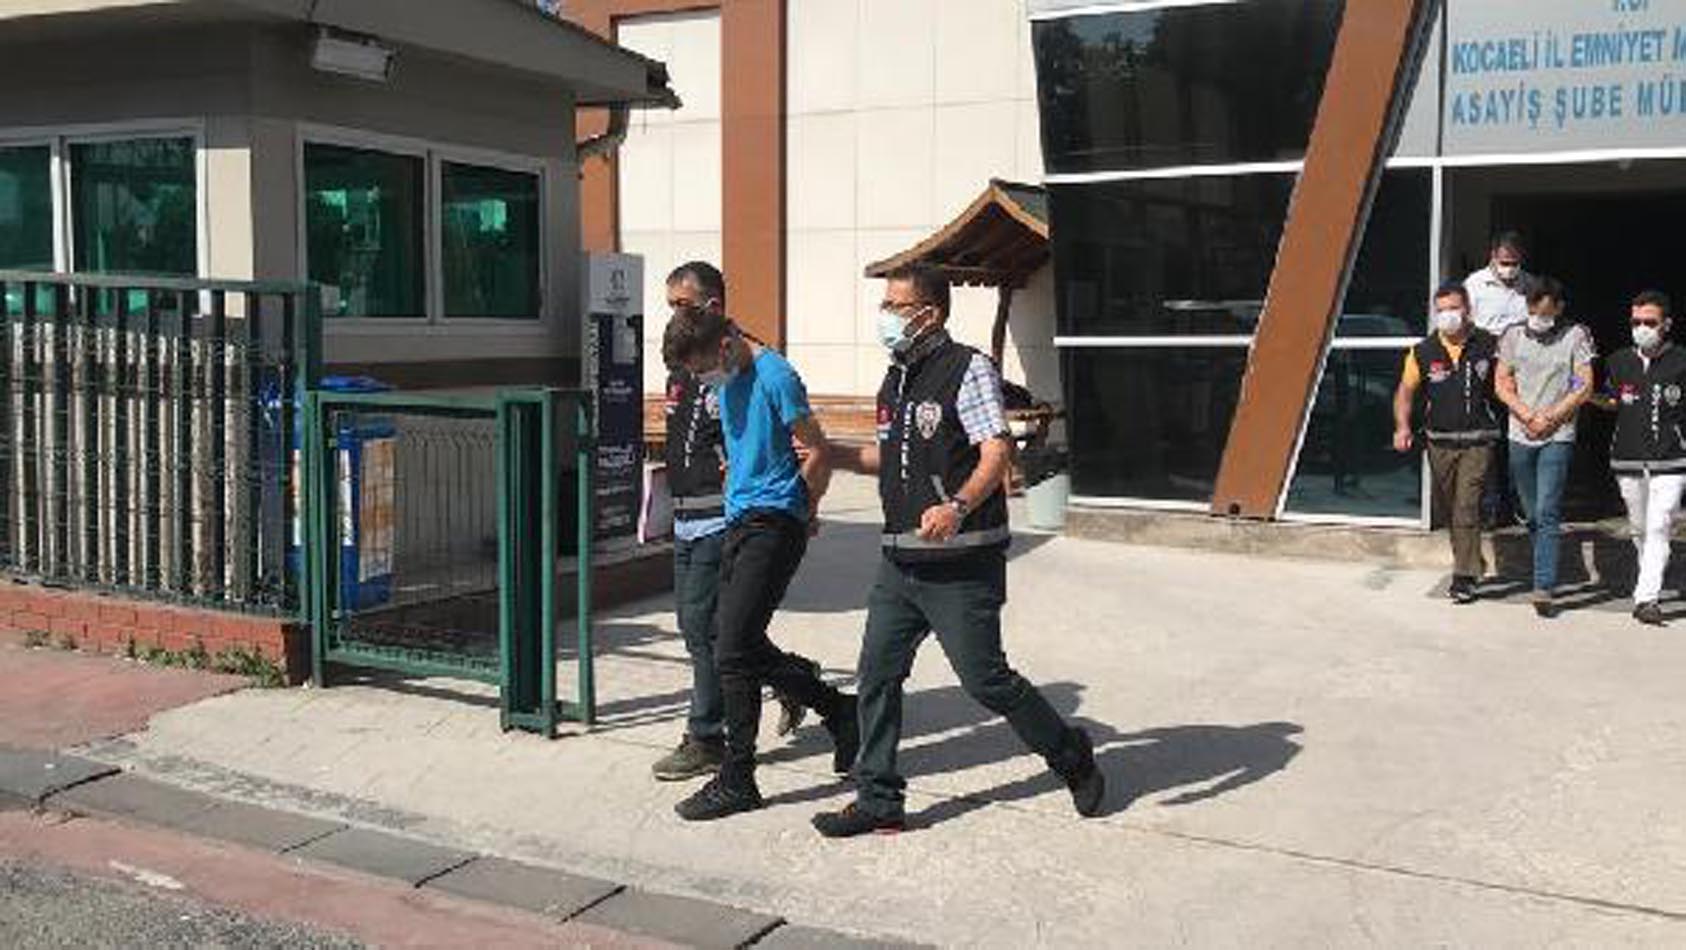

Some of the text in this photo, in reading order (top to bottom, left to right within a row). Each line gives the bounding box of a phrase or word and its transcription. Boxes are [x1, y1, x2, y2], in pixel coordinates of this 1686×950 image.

[1452, 32, 1537, 73] KOCAELİ
[1544, 30, 1564, 68] İL
[1571, 23, 1666, 67] EMNİYET
[1452, 81, 1541, 130] ASAYİŞ
[1554, 85, 1622, 129] ŞUBE
